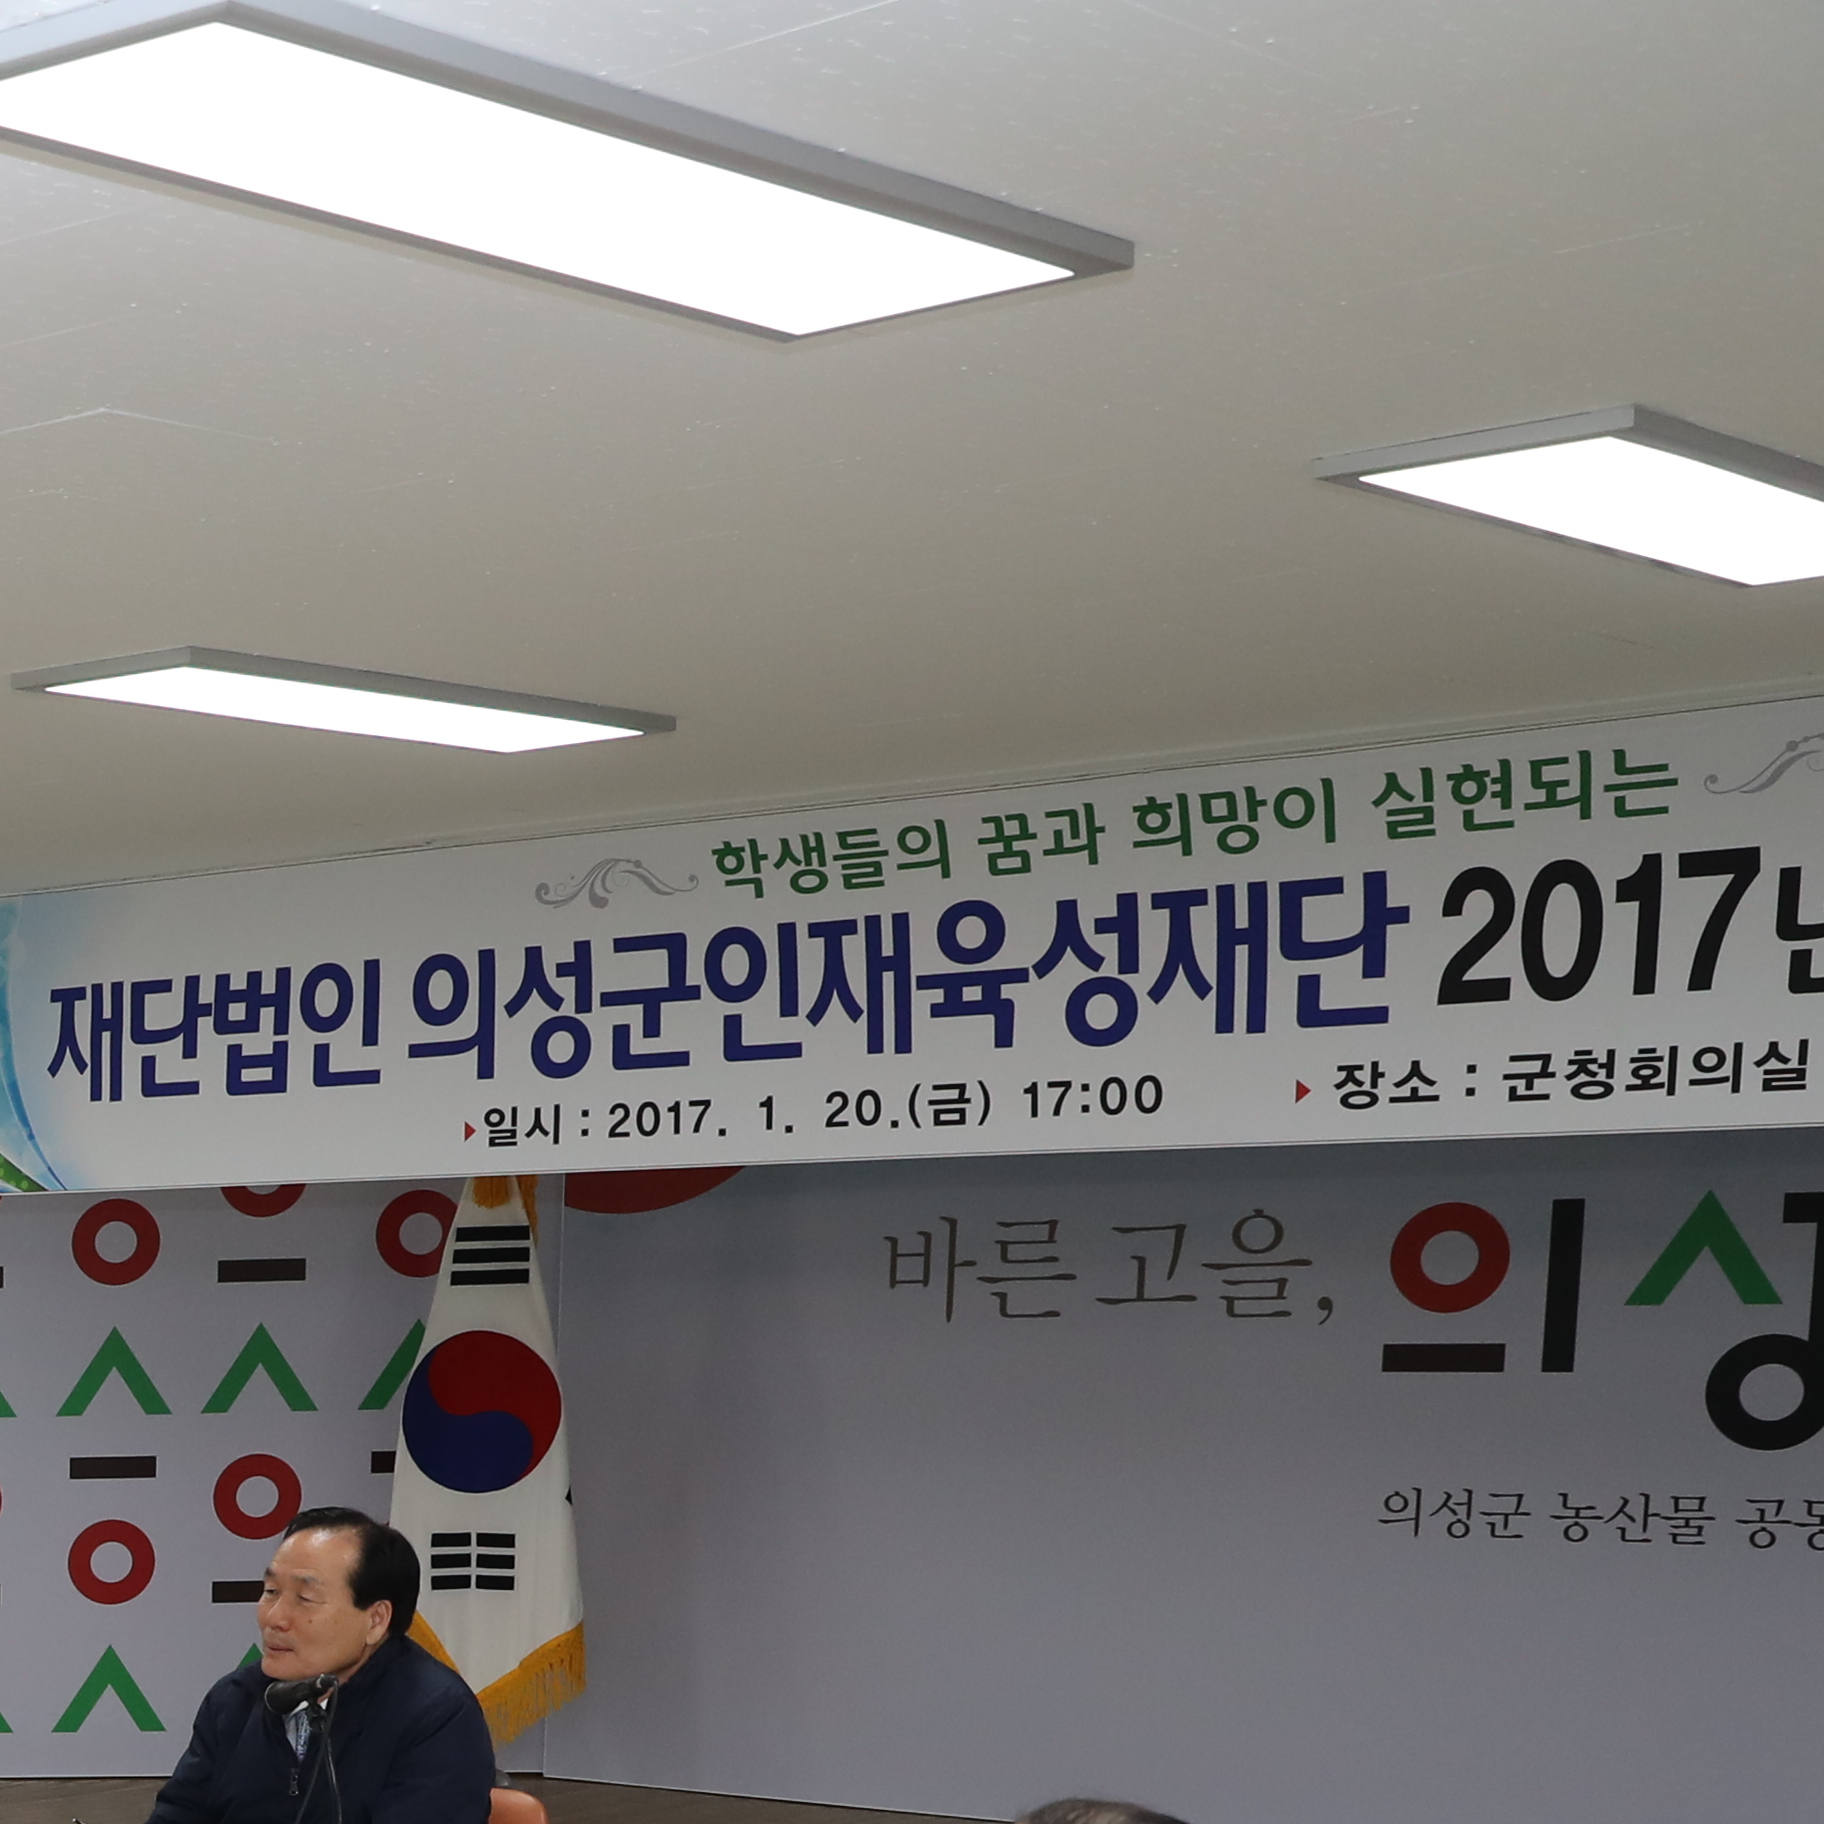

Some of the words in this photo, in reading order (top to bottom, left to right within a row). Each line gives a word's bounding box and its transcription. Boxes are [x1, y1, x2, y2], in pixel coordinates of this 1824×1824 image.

[711, 818, 953, 900] 학생들의
[976, 801, 1107, 877] 꿈과
[1131, 777, 1337, 858] 희망이
[1370, 748, 1679, 841] 실현되는
[46, 957, 382, 1103] 재단법인
[407, 870, 1411, 1081] 의성군인재육성재단
[482, 1102, 561, 1148] 일시
[606, 1098, 728, 1141] 2017.
[758, 1095, 795, 1135] 1.
[1022, 1074, 1165, 1119] 17:00
[1332, 1058, 1441, 1111] 장소
[1501, 1037, 1811, 1103] 군청회의실
[882, 1215, 1078, 1324] 바른
[1094, 1208, 1334, 1326] 고을,
[1377, 1486, 1532, 1540] 의성군
[1548, 1491, 1717, 1547] 농산물
